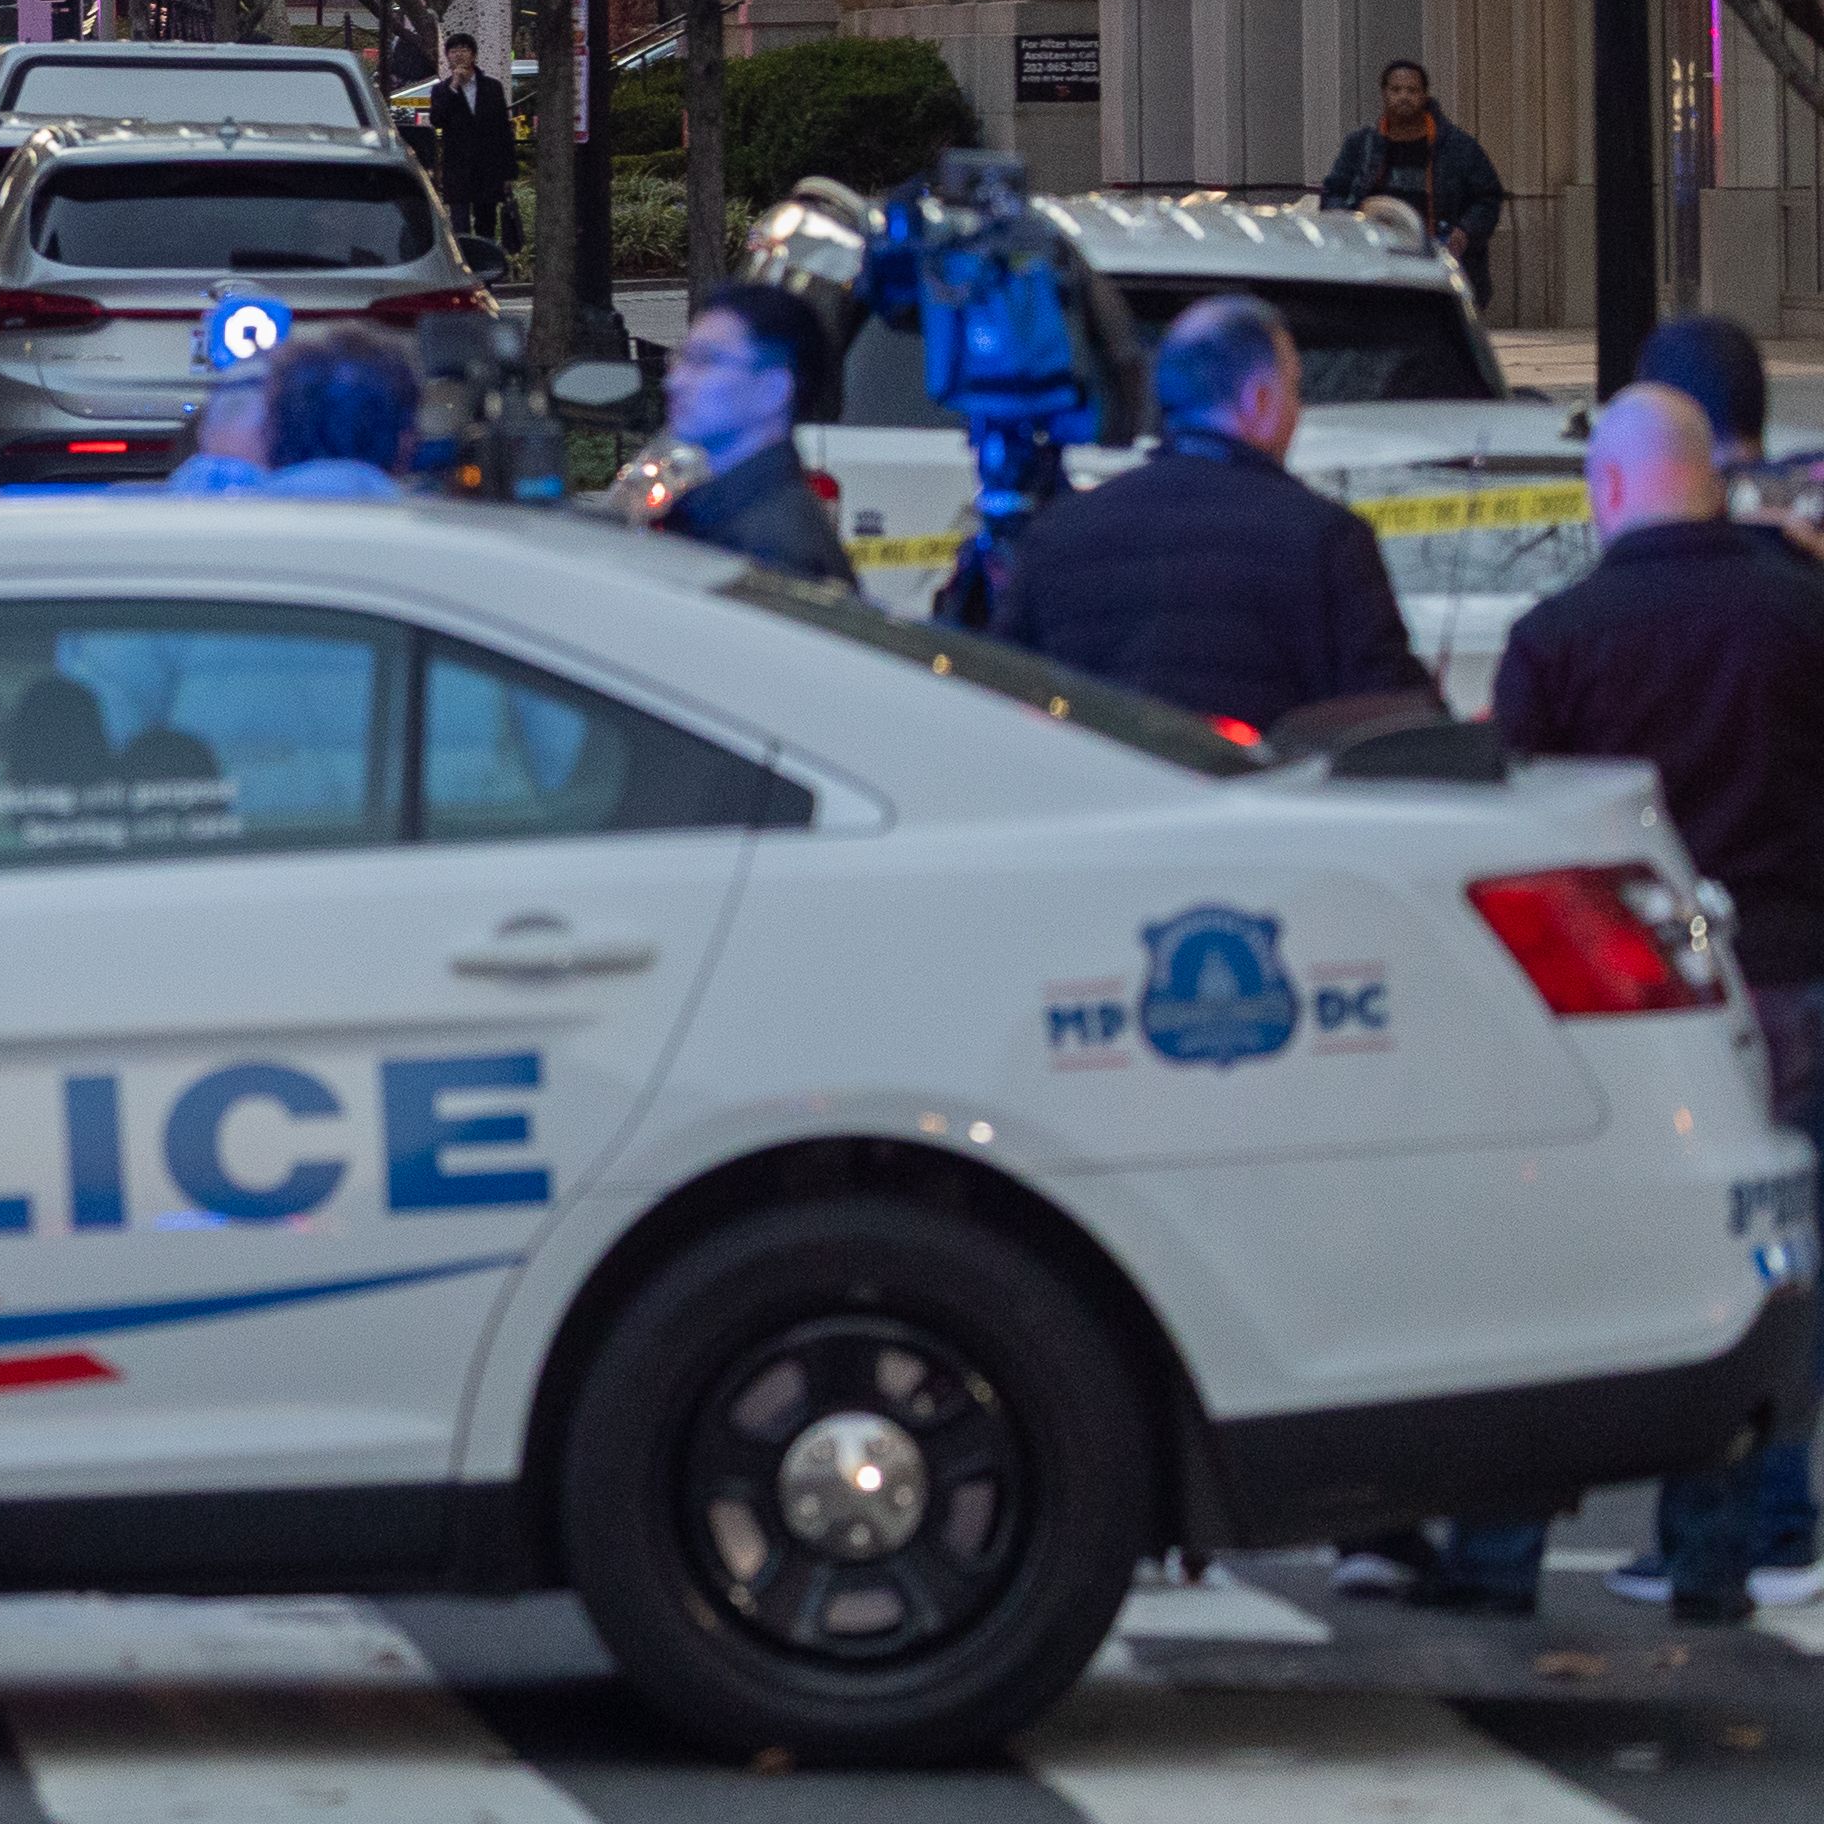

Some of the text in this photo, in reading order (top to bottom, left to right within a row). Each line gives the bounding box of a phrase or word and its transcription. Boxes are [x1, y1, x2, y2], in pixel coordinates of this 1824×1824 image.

[1021, 39, 1038, 48] For
[1039, 39, 1066, 48] After
[1048, 981, 1389, 1048] MP DC
